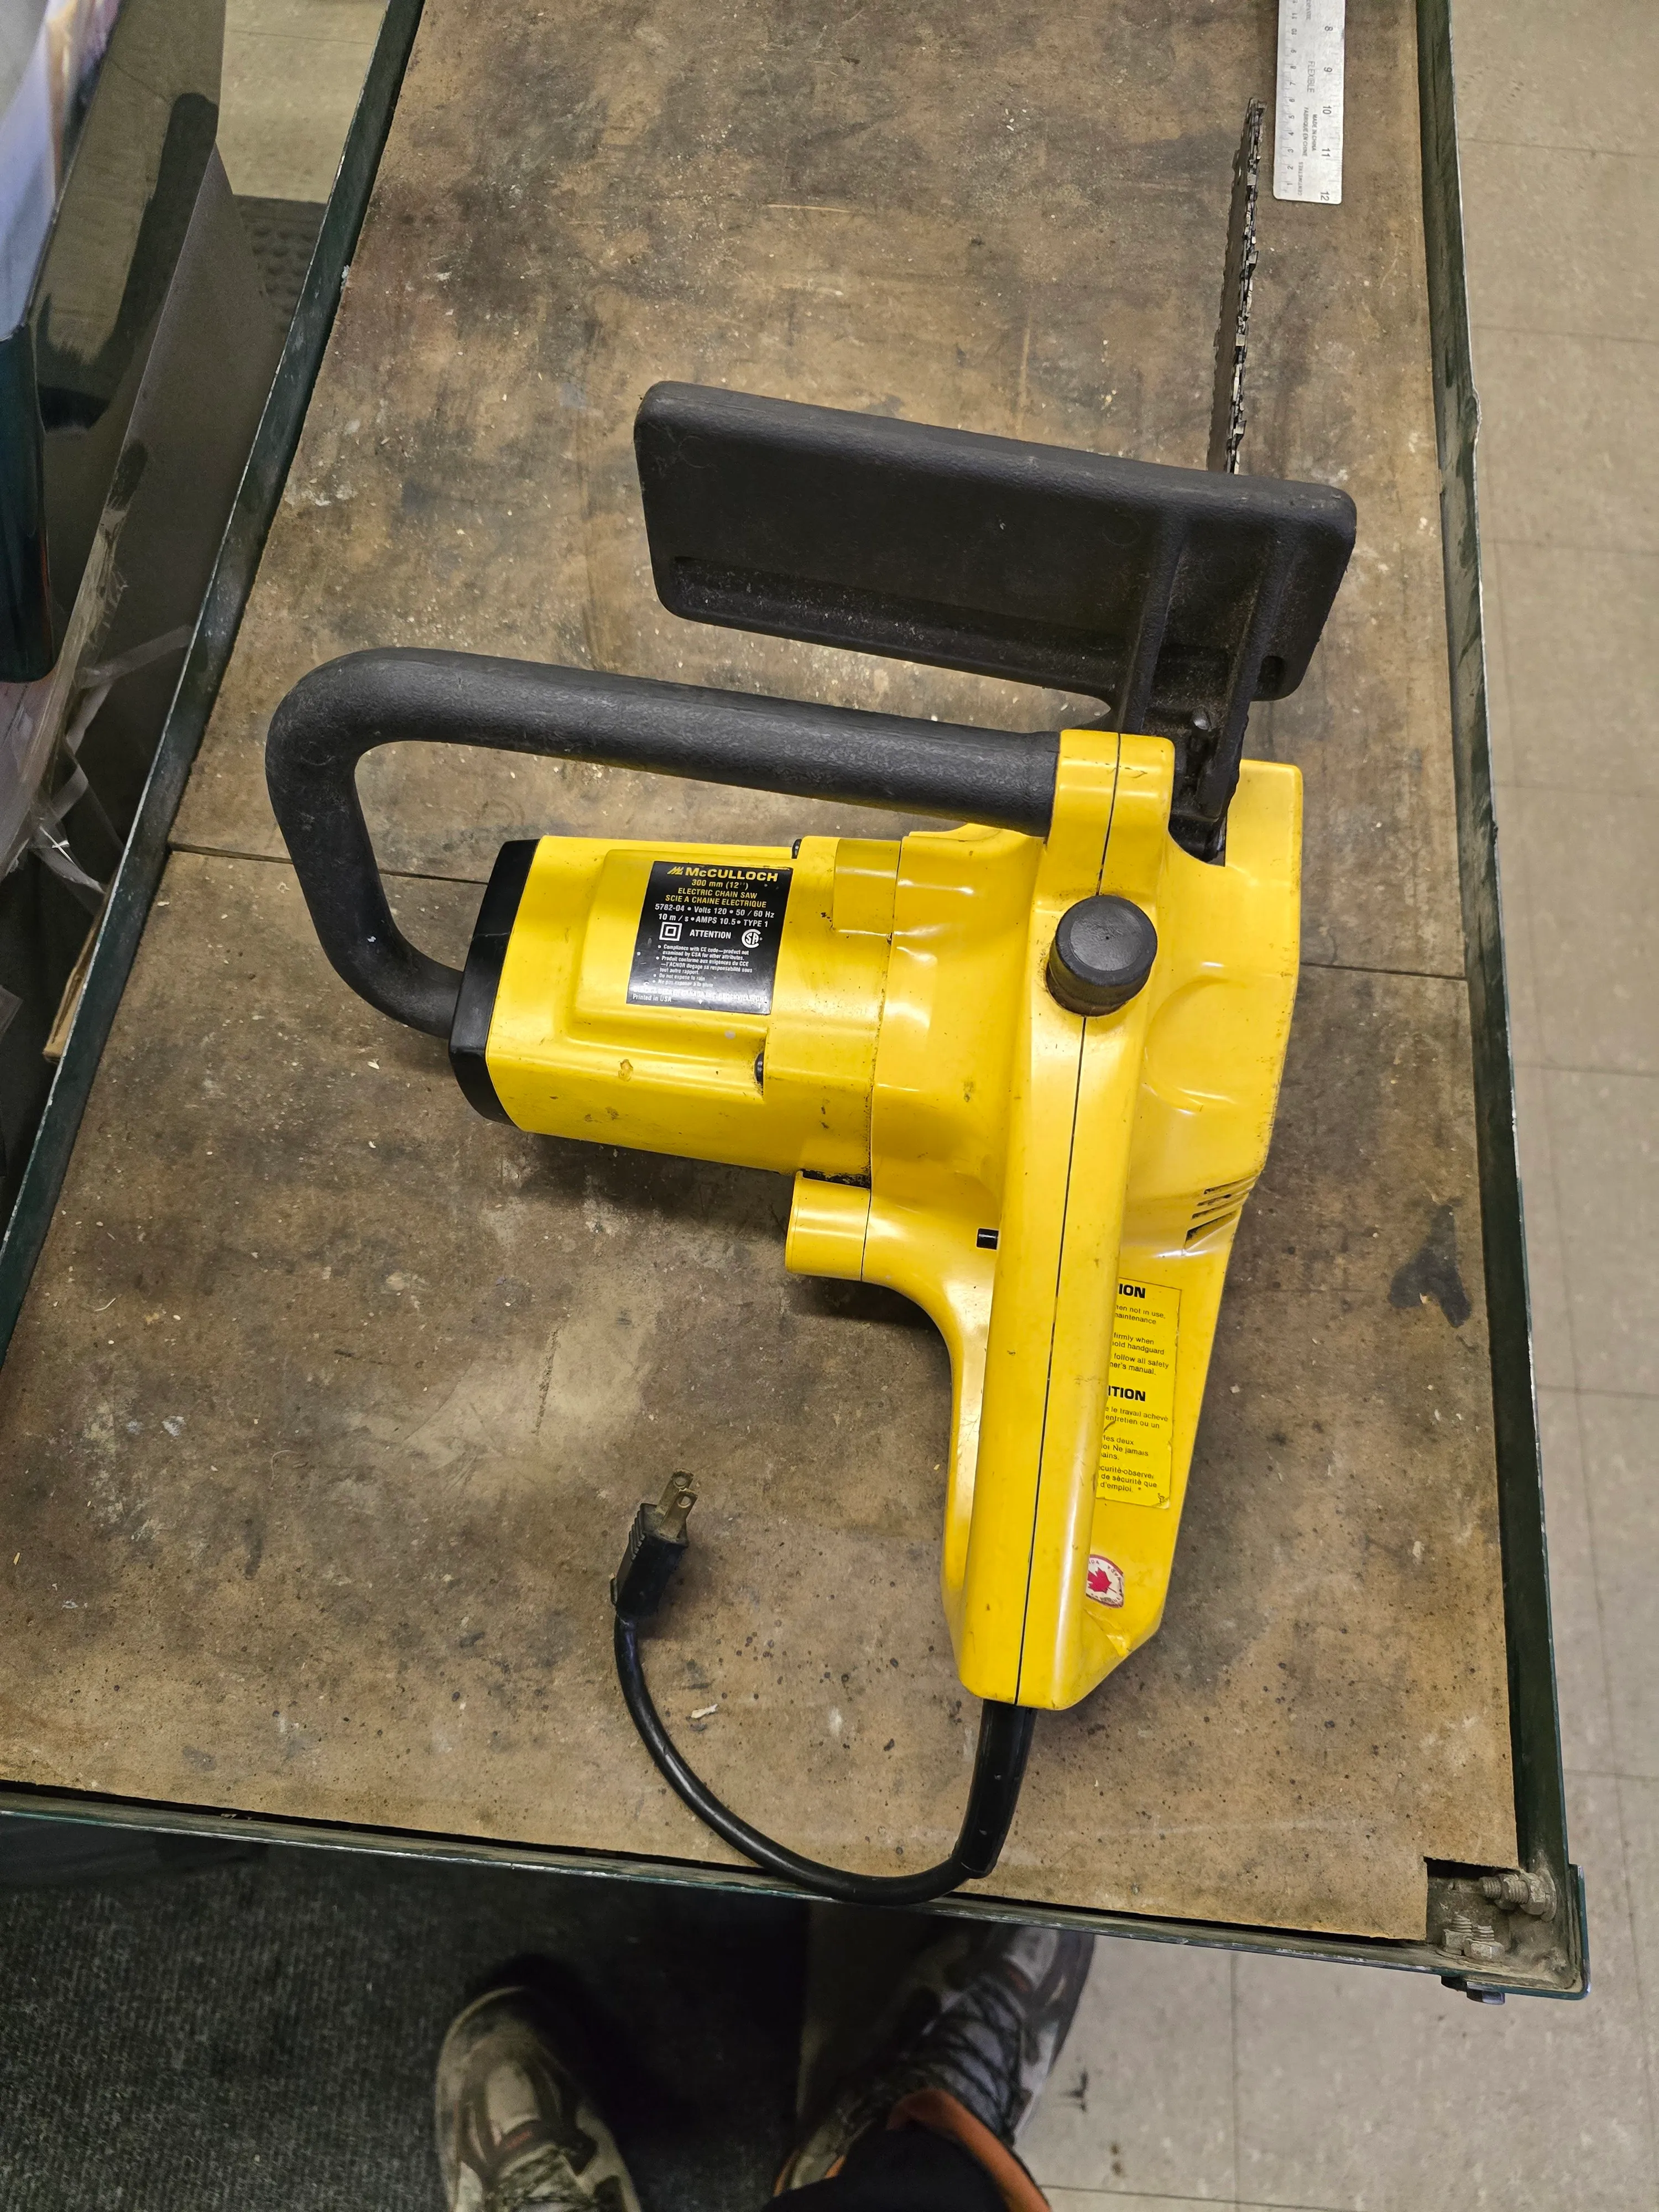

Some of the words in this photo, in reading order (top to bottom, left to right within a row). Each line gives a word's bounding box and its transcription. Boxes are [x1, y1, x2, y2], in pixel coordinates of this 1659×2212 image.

[1307, 61, 1315, 93] FLEXIBLE
[1322, 105, 1332, 114] 10
[1322, 148, 1331, 157] 11
[1321, 191, 1330, 201] 12
[685, 867, 779, 881] McCULLOCH
[678, 888, 713, 896] ELECTRIC
[655, 903, 685, 911] 5782-04
[692, 896, 720, 905] CHAINE
[722, 899, 767, 908] ELECTRIQUE
[695, 916, 717, 924] AMPS
[743, 919, 762, 927] TYPE
[689, 929, 732, 939] ATTENTION
[1118, 1283, 1146, 1299] ION
[1114, 1332, 1134, 1342] firmly
[1128, 1343, 1164, 1355] handguard
[1114, 1353, 1135, 1362] follow
[1147, 1360, 1169, 1369] safety
[1129, 1365, 1156, 1375] manual.
[1120, 1408, 1141, 1417] travail
[1125, 1447, 1149, 1456] jamais
